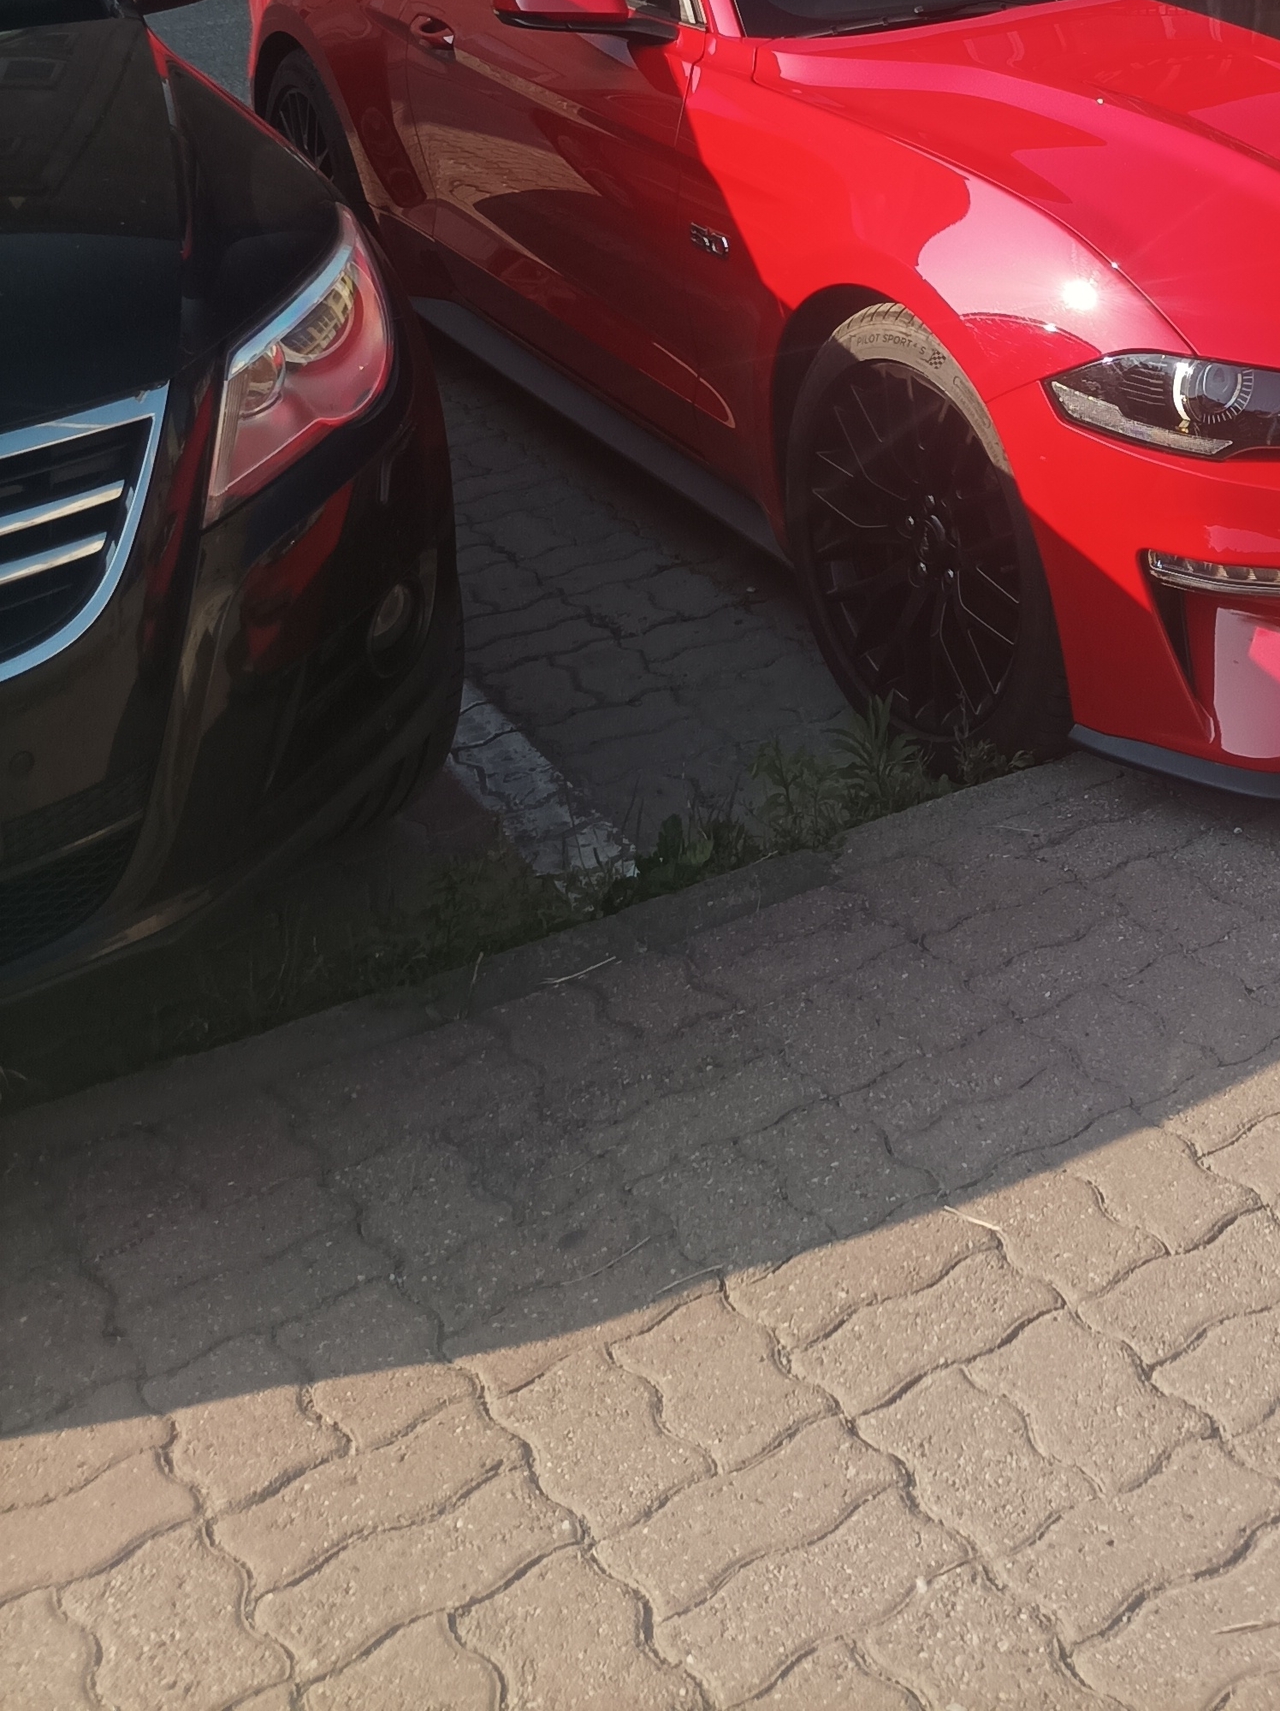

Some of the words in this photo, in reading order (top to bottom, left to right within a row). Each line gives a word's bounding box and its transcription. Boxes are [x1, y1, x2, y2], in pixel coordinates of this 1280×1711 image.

[857, 333, 881, 346] PILOT
[882, 333, 913, 347] SPORT
[918, 346, 927, 355] S
